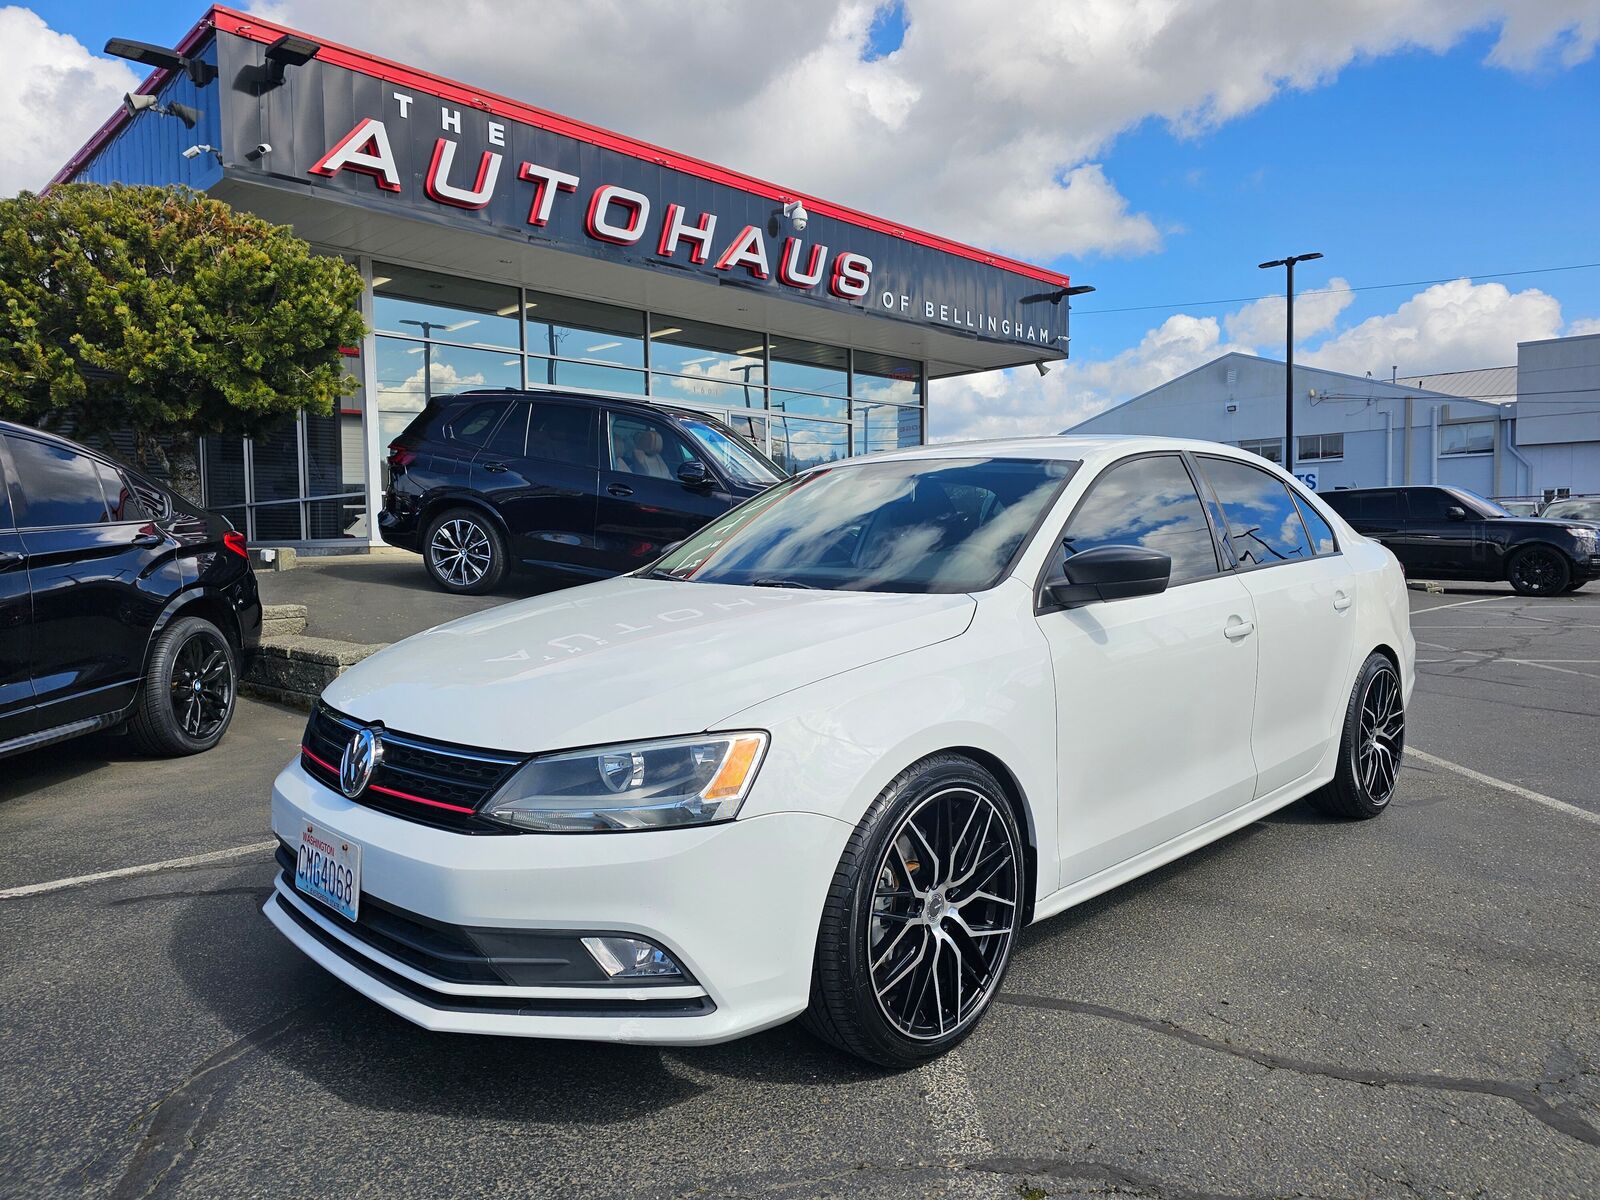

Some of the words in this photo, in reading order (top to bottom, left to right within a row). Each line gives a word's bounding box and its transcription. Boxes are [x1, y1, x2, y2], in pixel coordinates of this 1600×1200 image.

[394, 92, 505, 147] THE
[309, 118, 874, 300] AUTOHAUS
[882, 291, 910, 313] OF
[925, 301, 1049, 343] BELLINGHAM
[303, 832, 335, 857] WASHINGTON
[298, 844, 353, 906] CMG4068
